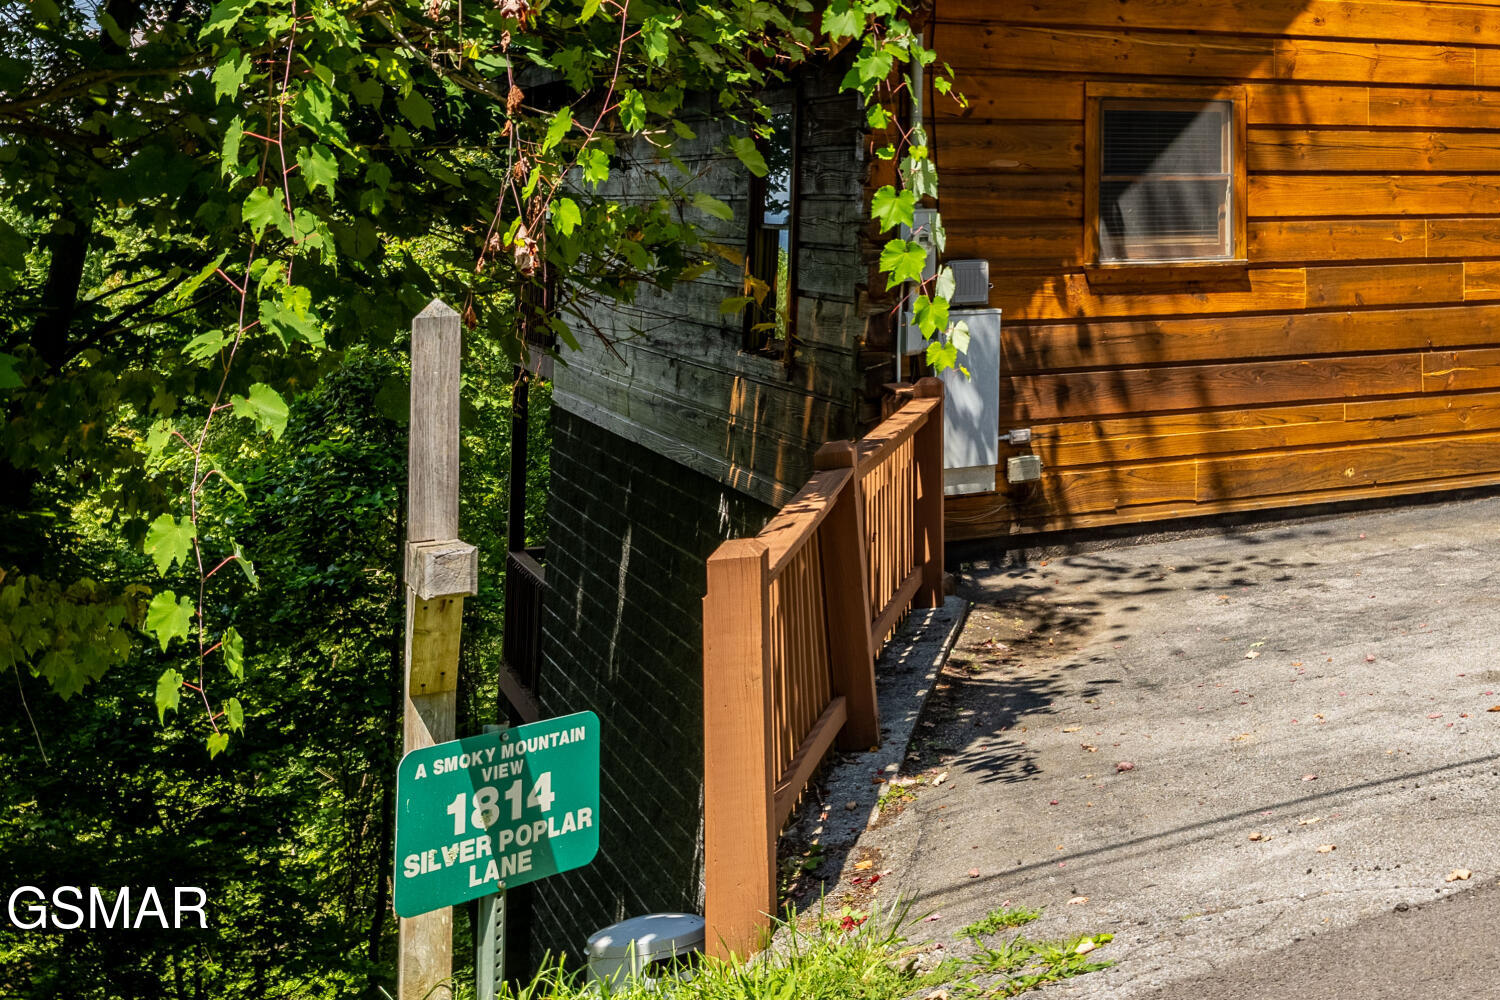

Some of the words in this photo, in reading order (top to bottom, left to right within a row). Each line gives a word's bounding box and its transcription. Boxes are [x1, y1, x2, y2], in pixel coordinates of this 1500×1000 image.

[414, 763, 427, 780] A
[433, 747, 496, 775] SMOKY
[501, 726, 586, 759] MOUNTAIN
[482, 759, 524, 782] VIEW
[447, 771, 555, 836] 1814
[403, 835, 492, 878] SILVER
[499, 807, 593, 850] POPLAR
[469, 849, 532, 888] LANE
